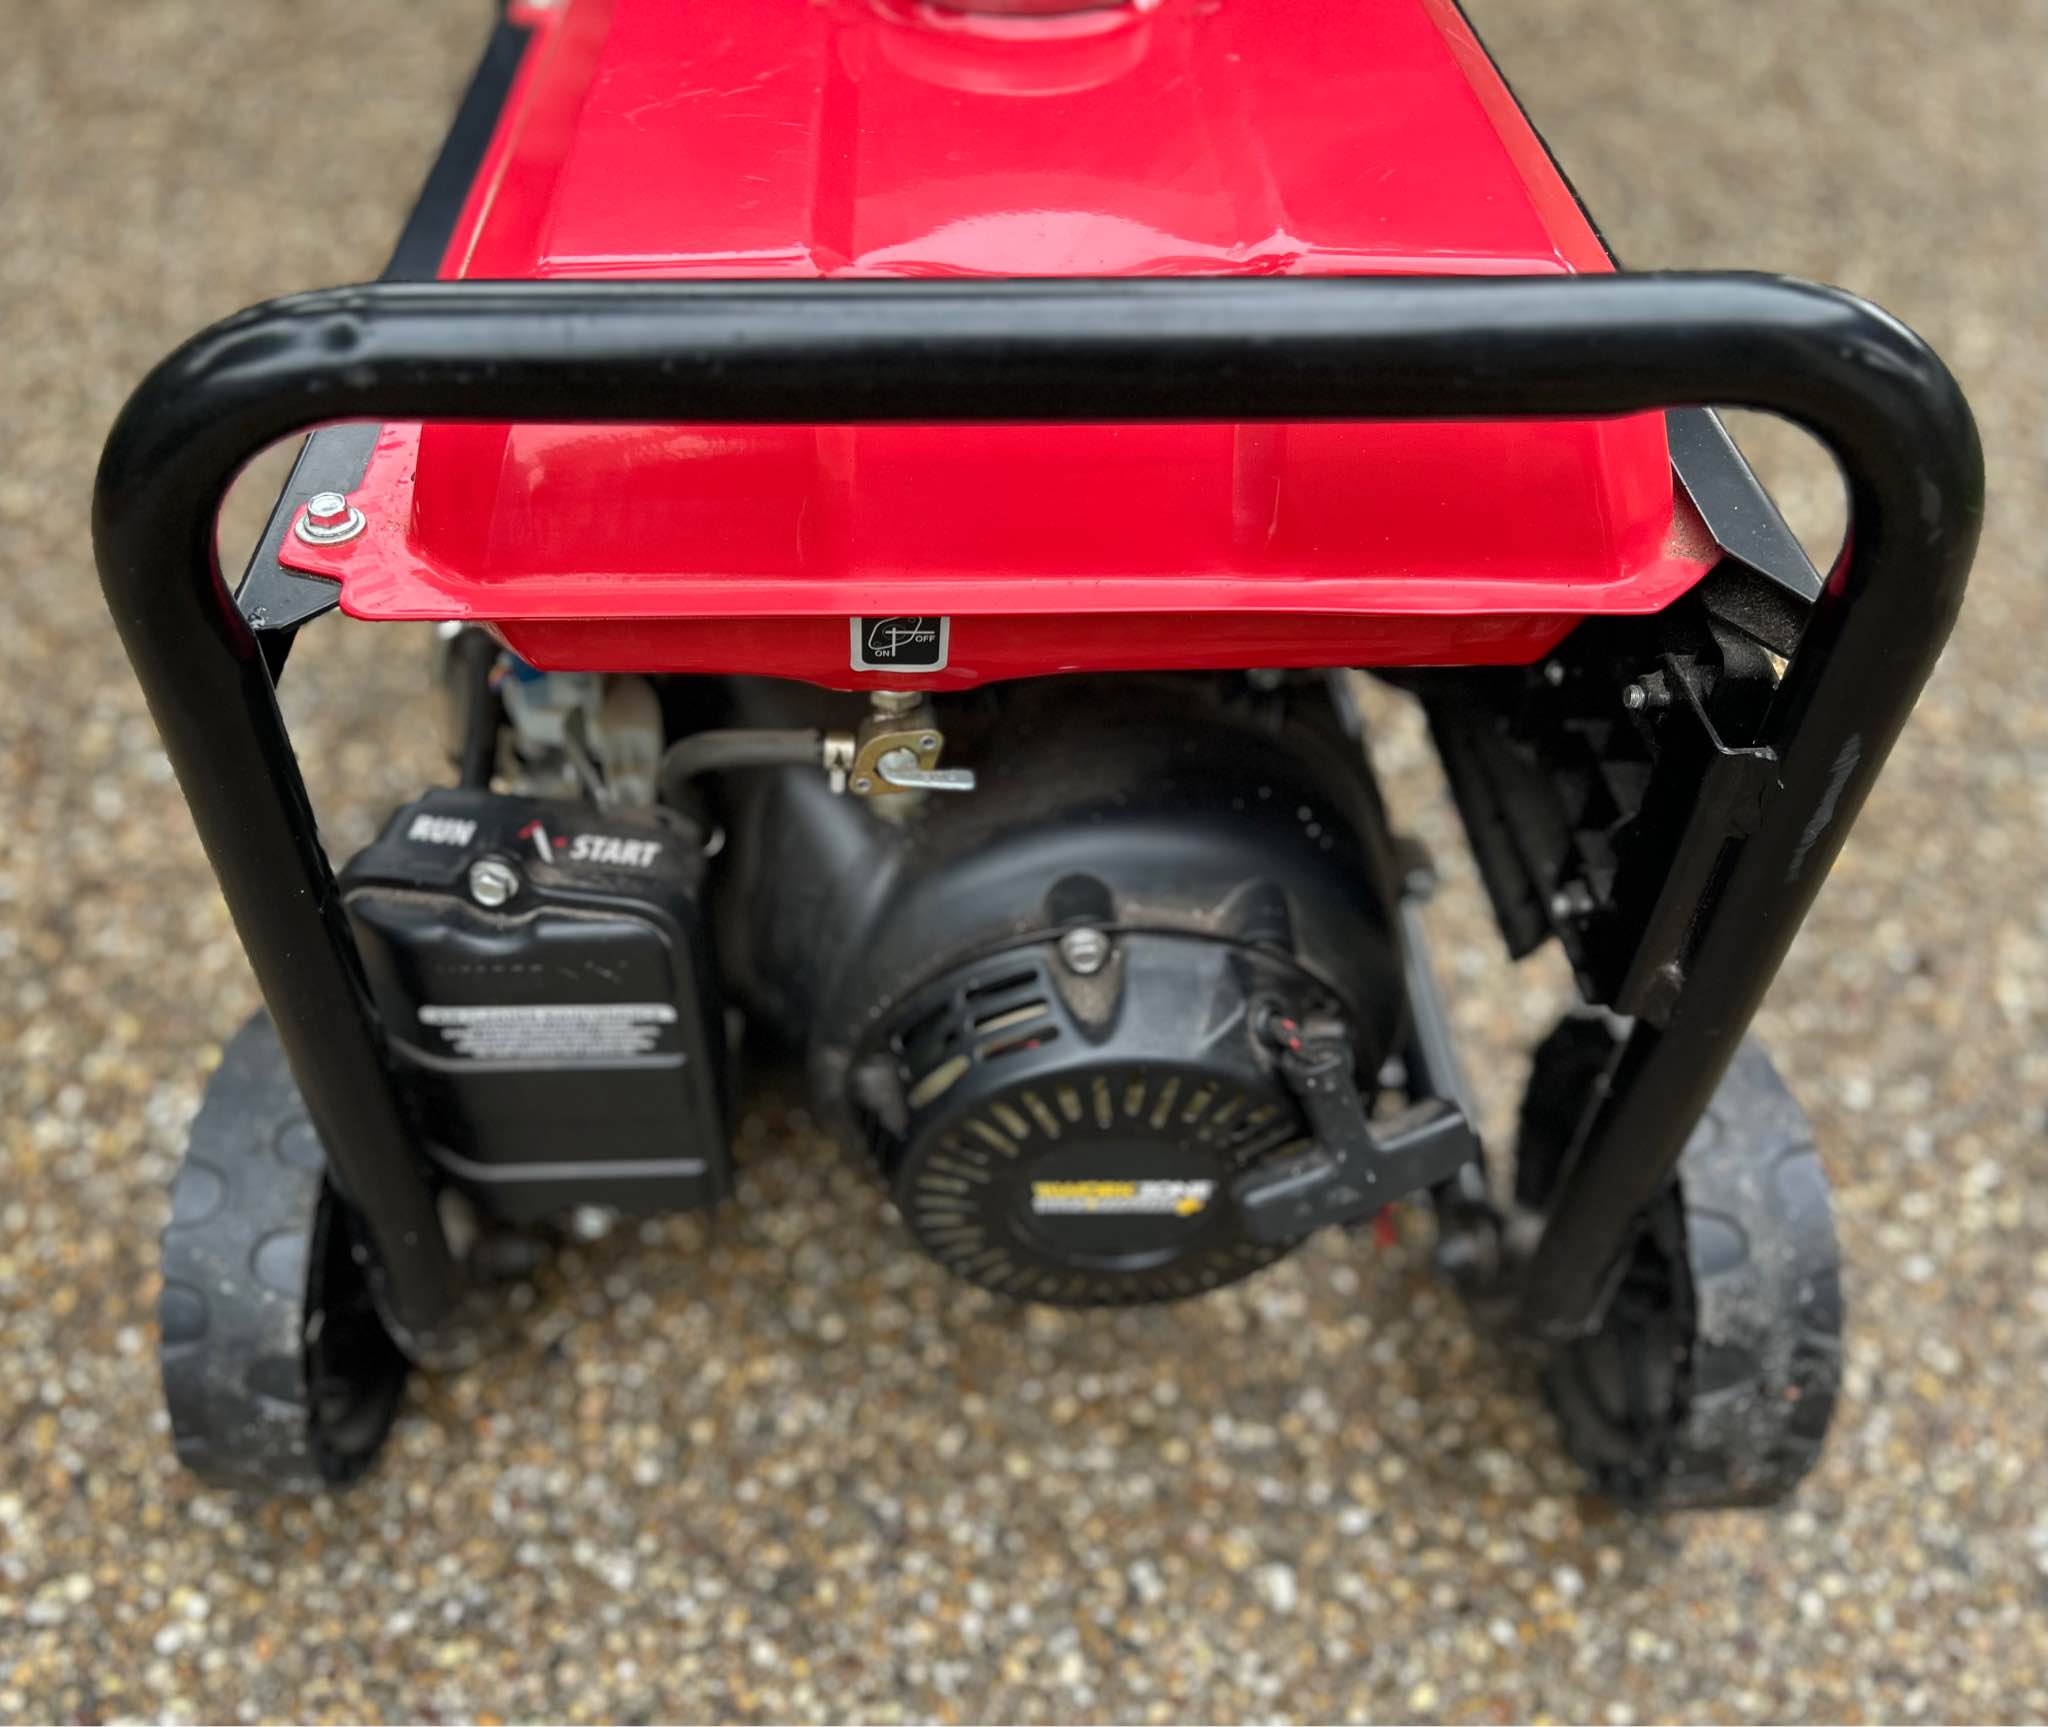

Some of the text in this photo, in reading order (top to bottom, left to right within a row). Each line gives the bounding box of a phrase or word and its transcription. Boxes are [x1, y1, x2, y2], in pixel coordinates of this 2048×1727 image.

[915, 635, 935, 643] OFF
[409, 815, 476, 846] RUN
[570, 834, 662, 867] START
